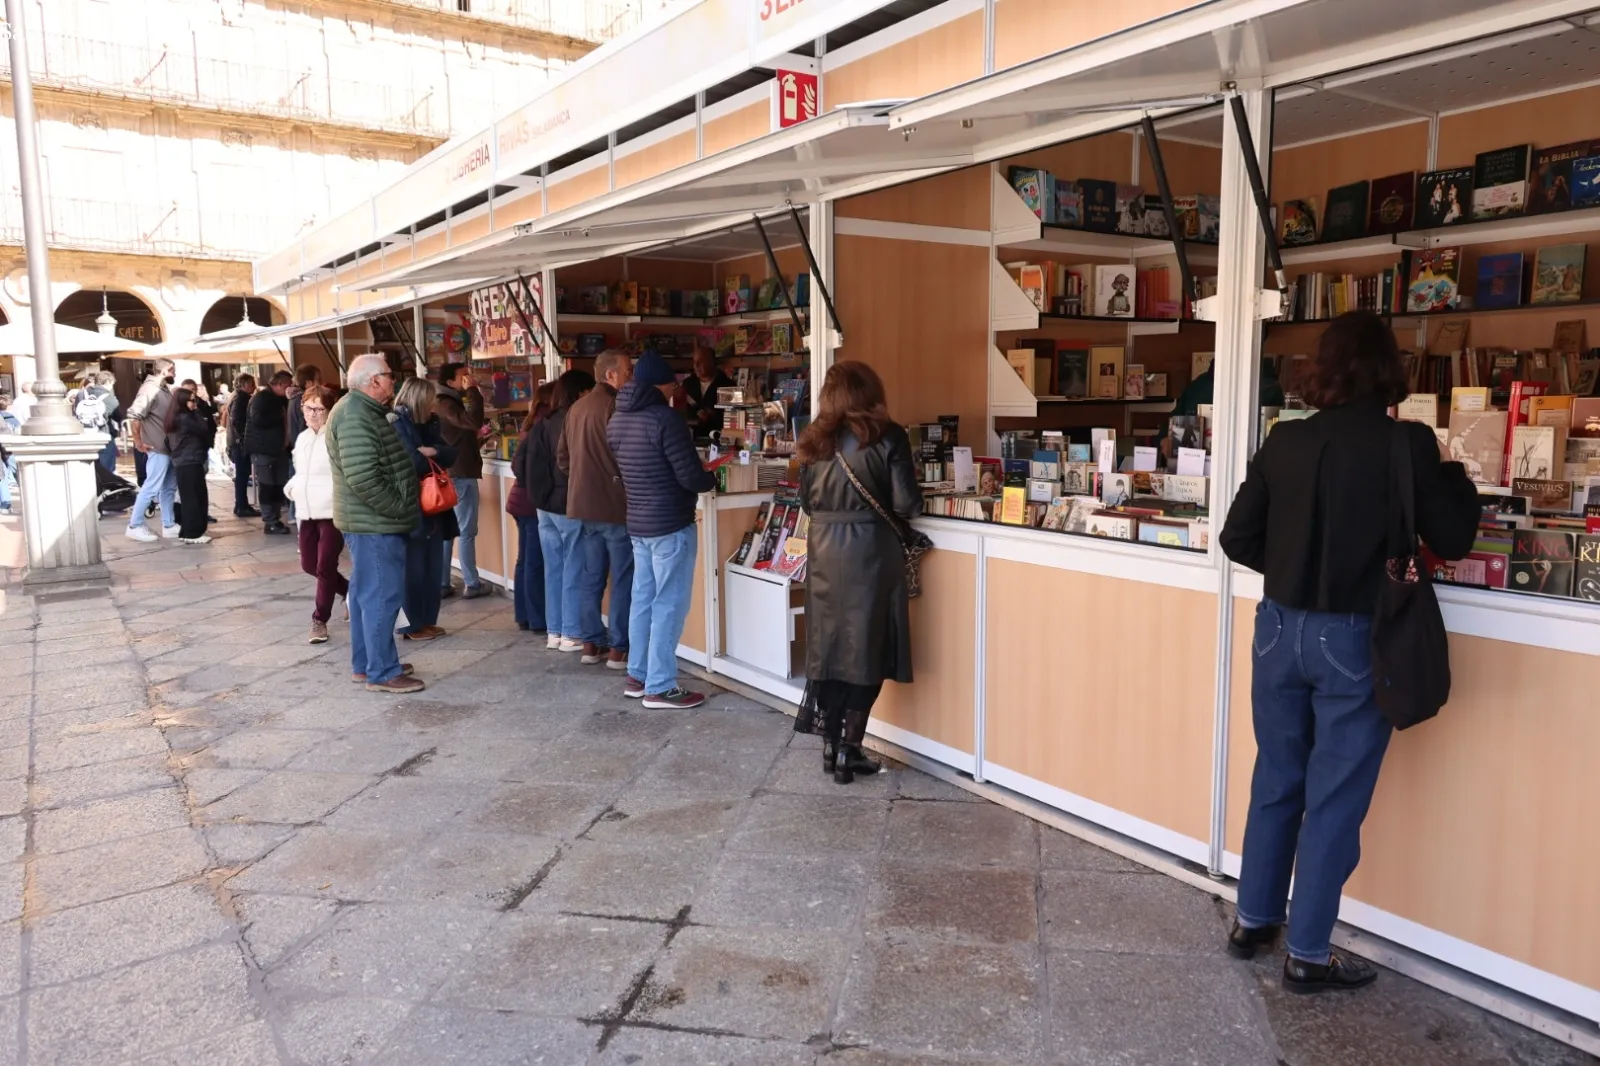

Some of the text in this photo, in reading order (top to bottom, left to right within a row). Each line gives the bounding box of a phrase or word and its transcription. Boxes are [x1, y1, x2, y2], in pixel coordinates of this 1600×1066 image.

[499, 121, 530, 155] RIVAS
[532, 110, 571, 137] SALAMANCA
[1552, 150, 1579, 162] BIBLIA
[1421, 171, 1470, 183] FRIENDS
[1516, 481, 1564, 493] VESUVIUS
[1517, 538, 1569, 560] KING
